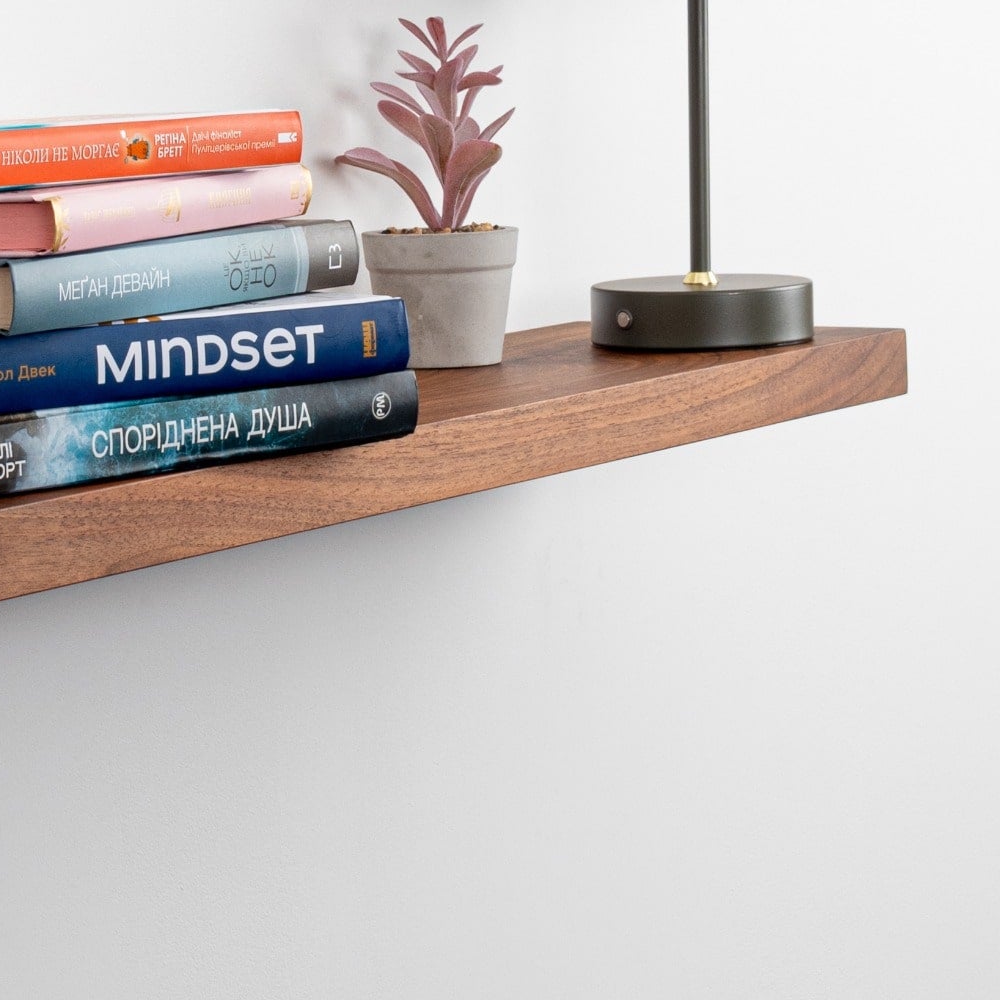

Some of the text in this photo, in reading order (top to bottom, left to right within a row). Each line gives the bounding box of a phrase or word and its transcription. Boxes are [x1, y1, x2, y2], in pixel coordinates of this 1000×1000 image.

[154, 132, 187, 146] РЕГІНА
[1, 147, 50, 166] НІКОЛИ
[53, 145, 68, 162] НЕ
[71, 142, 120, 160] МОРГАЄ
[157, 145, 184, 159] БРЕТТ
[249, 247, 263, 285] НЕ
[59, 266, 170, 301] МЕҐАН ДЕВАЙН
[17, 363, 56, 380] Двек
[91, 401, 313, 459] СПОРІДНЕНА ДУША
